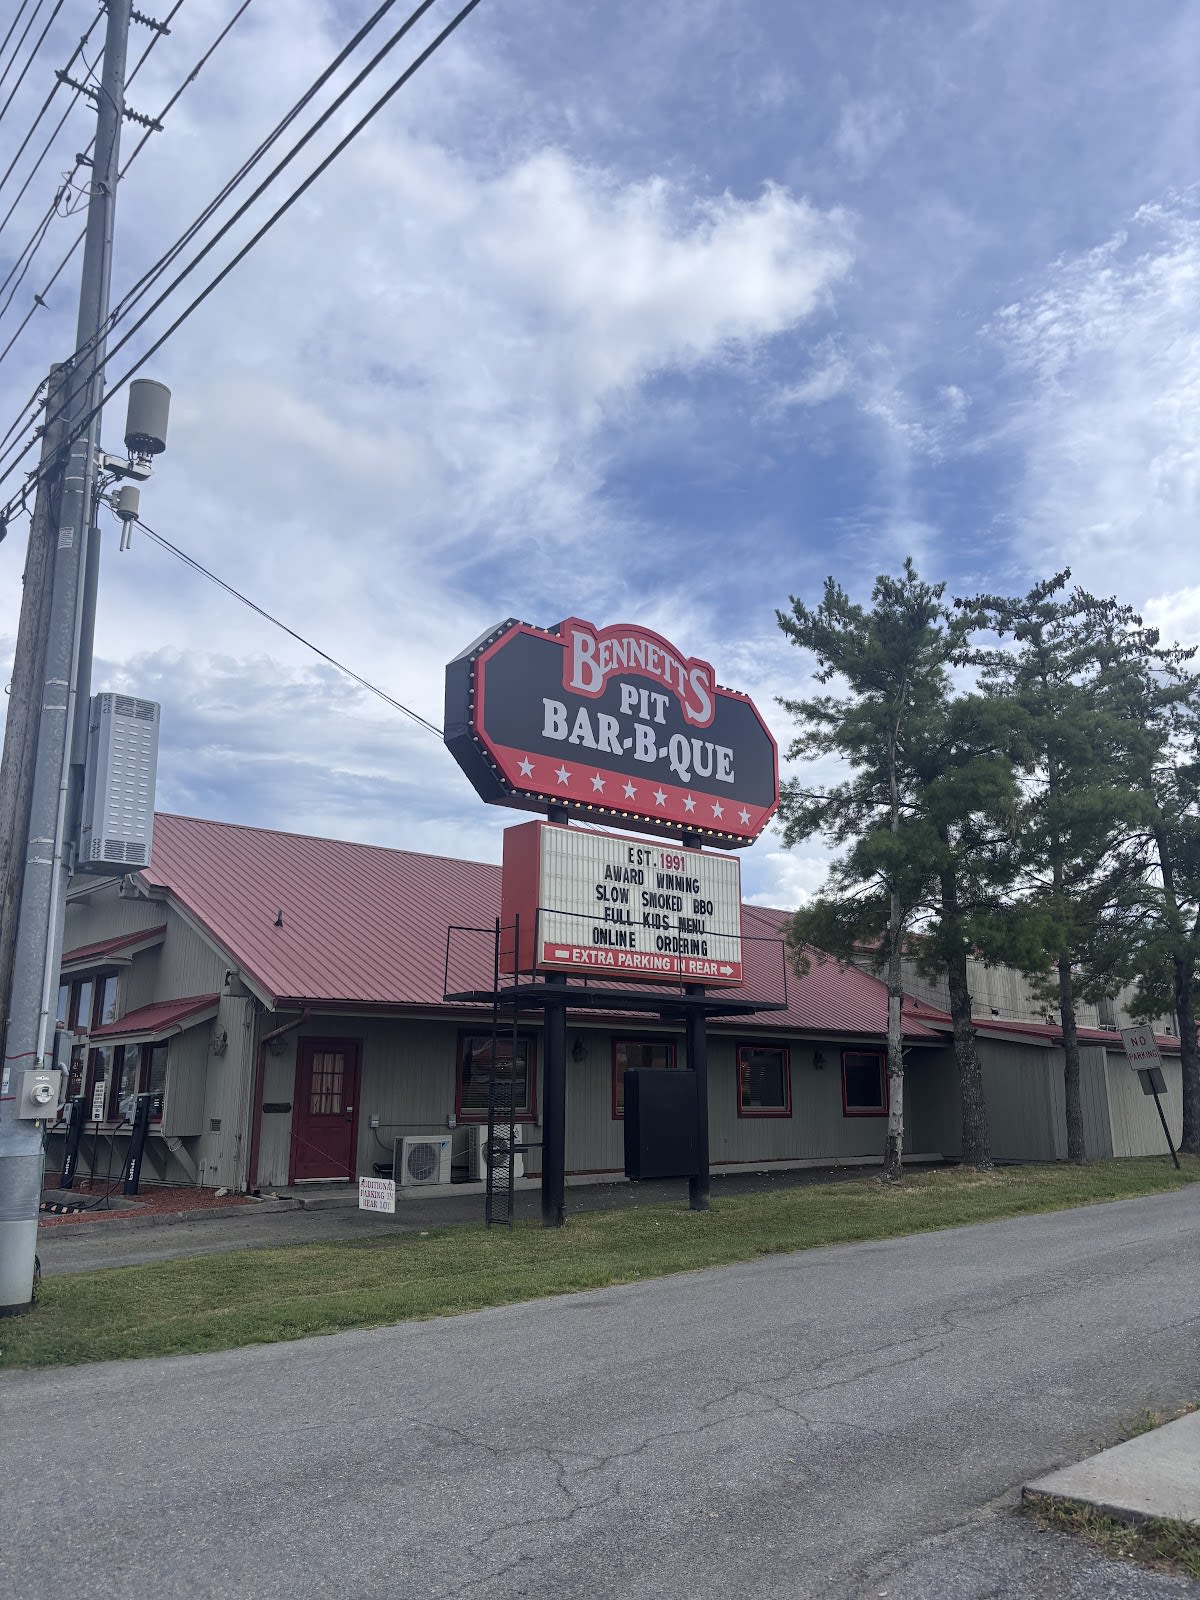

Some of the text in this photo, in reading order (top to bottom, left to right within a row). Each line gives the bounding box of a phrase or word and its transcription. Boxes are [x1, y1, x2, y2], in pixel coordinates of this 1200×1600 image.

[570, 630, 711, 723] BENNETTS
[619, 683, 669, 725] PIT
[542, 698, 735, 783] BAR-B-QUE
[628, 847, 685, 871] EST. 1991
[604, 864, 700, 894] AWARD WINNING
[595, 884, 713, 916] SLOW SMOKED BBQ
[604, 907, 705, 935] FULL KIDS MENU
[592, 927, 708, 956] ONLINE ORDERING
[572, 948, 718, 975] EXTRA PARKING IN REAR
[1129, 1050, 1159, 1060] PARKING
[1130, 1036, 1146, 1046] NO
[360, 1190, 385, 1199] PARKING
